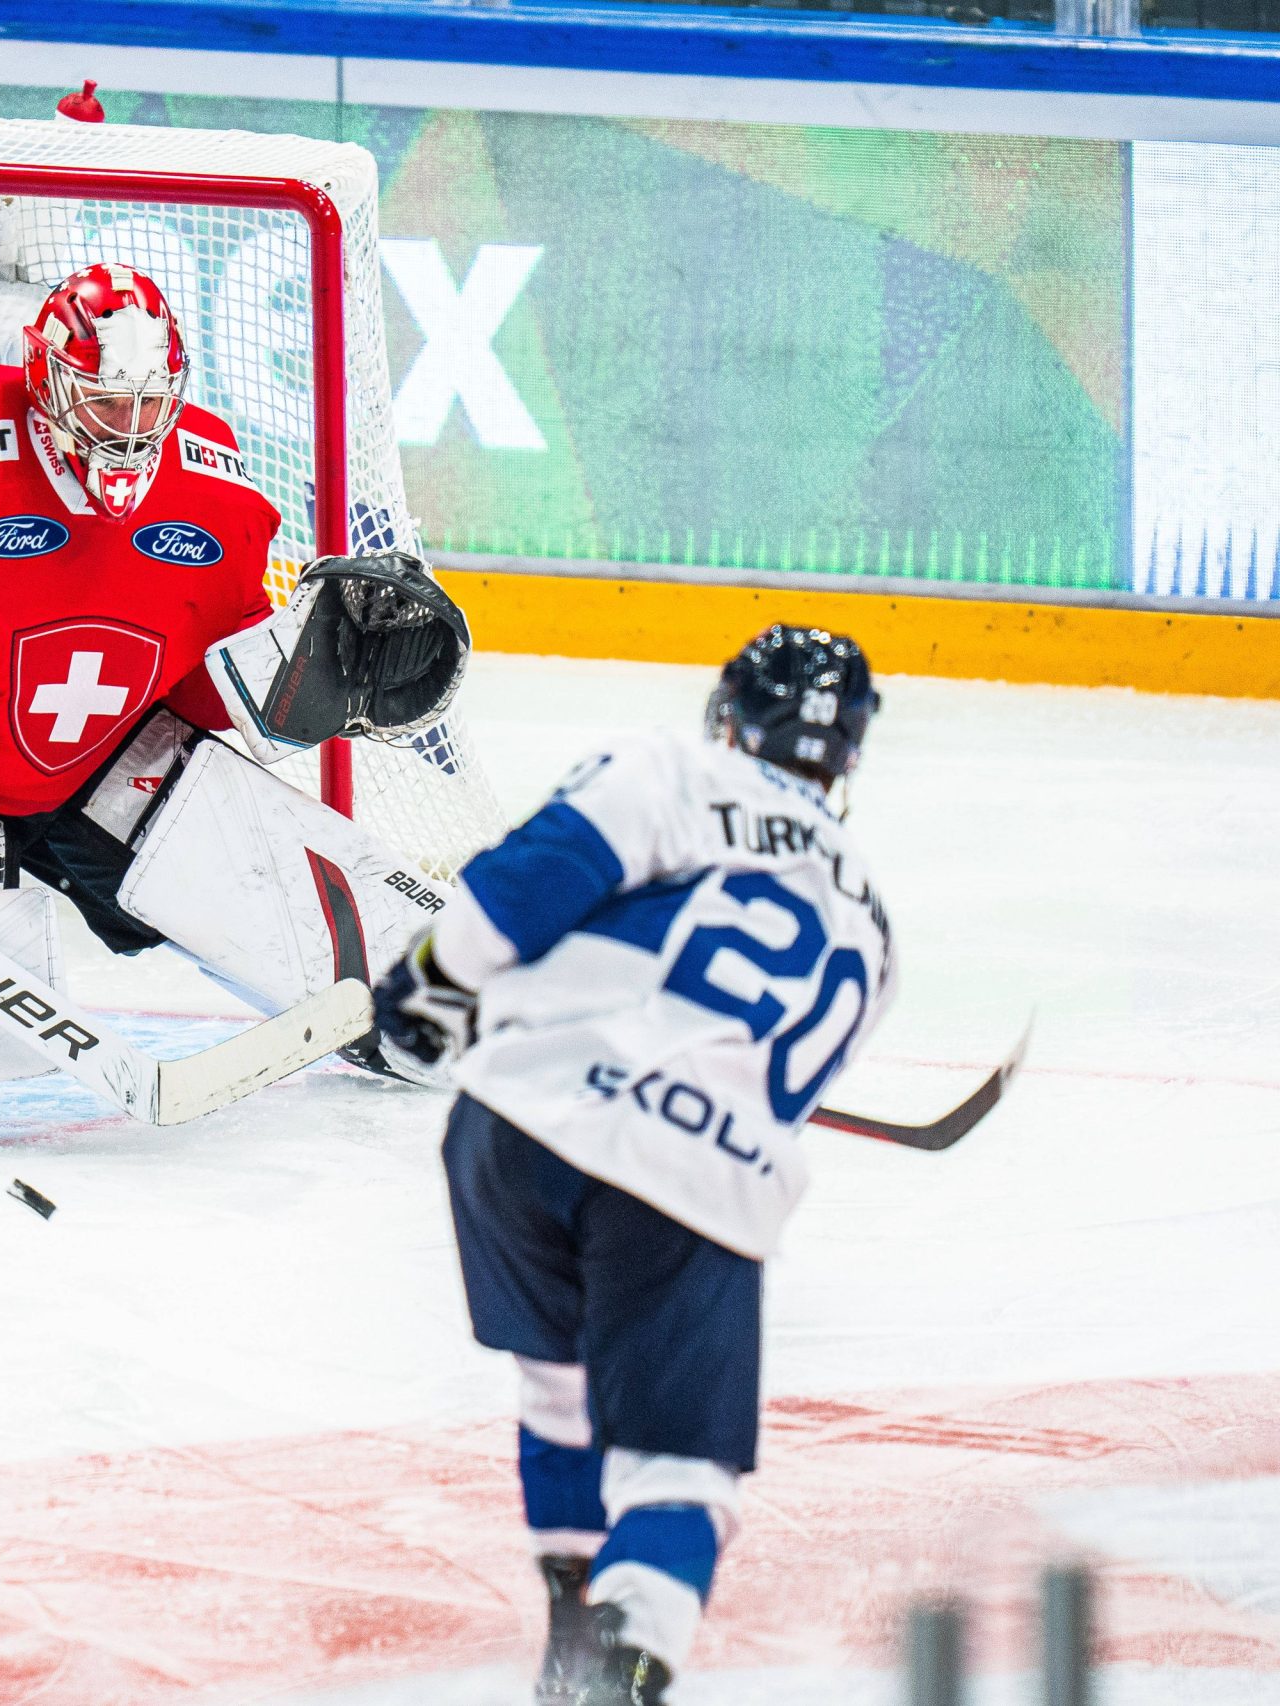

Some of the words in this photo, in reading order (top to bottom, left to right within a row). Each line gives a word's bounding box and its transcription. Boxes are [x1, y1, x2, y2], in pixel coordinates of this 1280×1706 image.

[41, 435, 66, 476] SWISS
[152, 527, 207, 560] Ford
[663, 870, 867, 1124] 20
